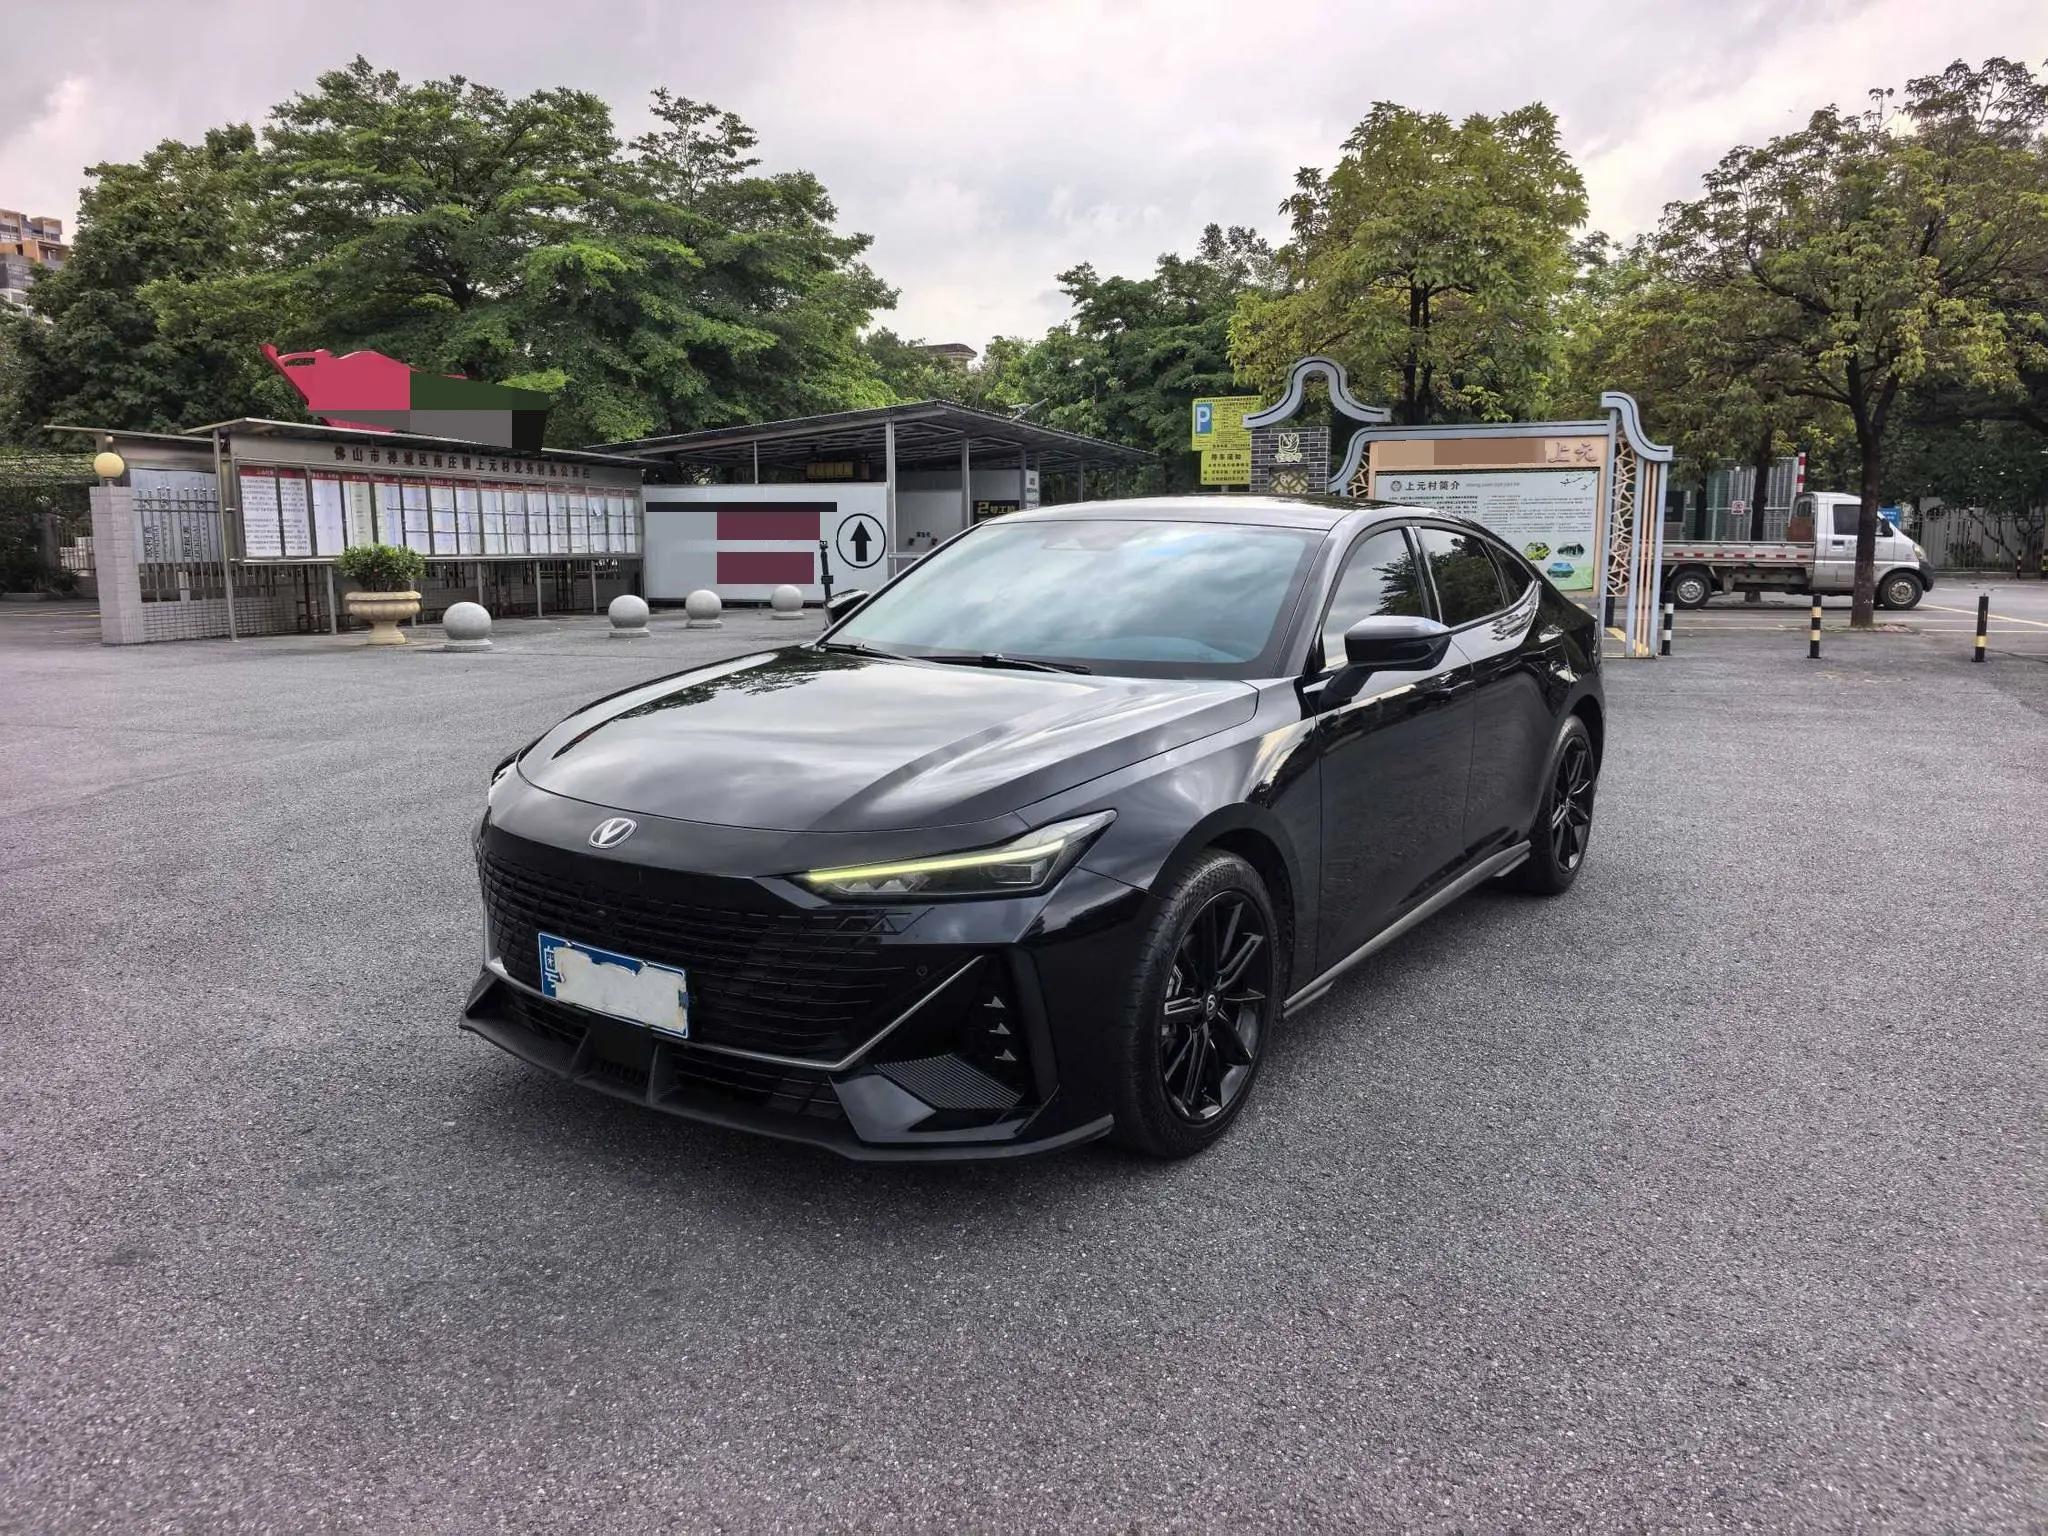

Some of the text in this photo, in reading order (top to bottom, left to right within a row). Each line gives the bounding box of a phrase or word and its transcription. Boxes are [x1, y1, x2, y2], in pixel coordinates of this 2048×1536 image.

[1196, 406, 1210, 433] P
[1405, 480, 1461, 492] 上元村简介
